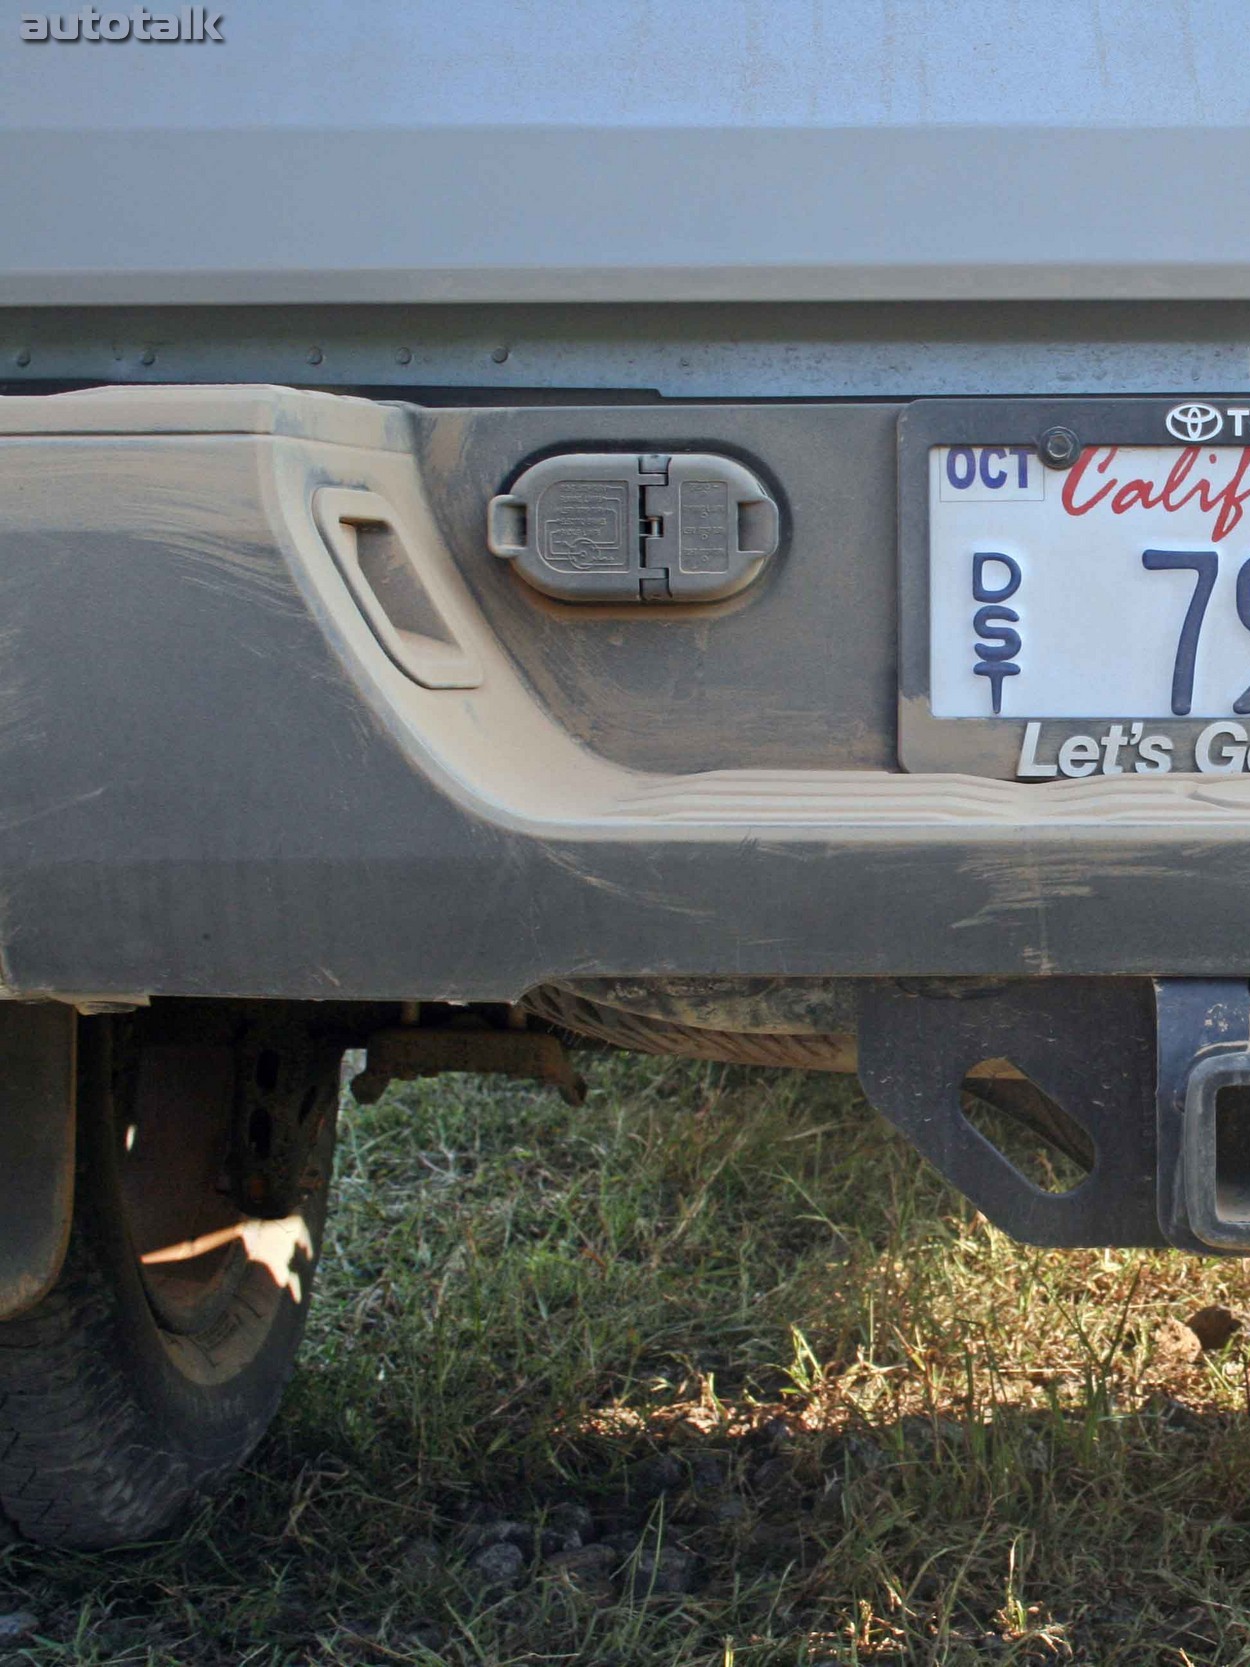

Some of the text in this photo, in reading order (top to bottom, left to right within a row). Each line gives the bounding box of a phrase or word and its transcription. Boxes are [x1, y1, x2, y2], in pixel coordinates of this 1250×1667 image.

[946, 447, 1038, 490] OCT
[972, 552, 1022, 714] DST
[1016, 721, 1175, 778] Let's
